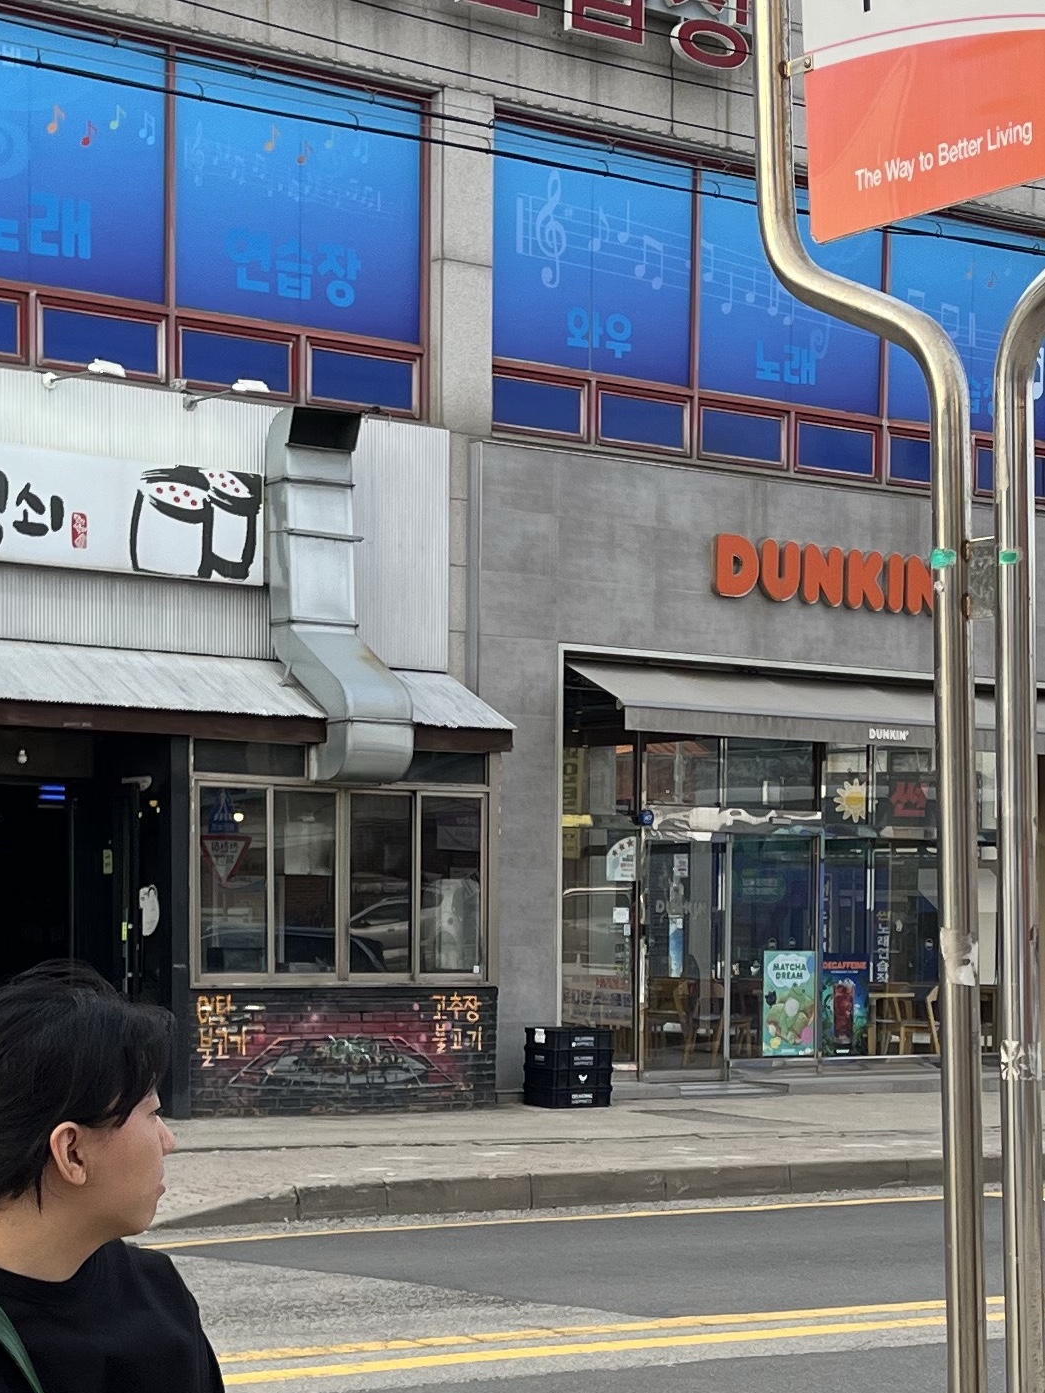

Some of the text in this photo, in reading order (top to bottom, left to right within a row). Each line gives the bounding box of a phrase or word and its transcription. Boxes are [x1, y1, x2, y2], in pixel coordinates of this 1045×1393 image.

[855, 121, 1033, 192] The Way to Better Living
[225, 225, 360, 308] 연습장
[566, 307, 632, 358] 와우
[756, 339, 817, 386] 노래
[868, 728, 910, 740] DUNKIN'
[772, 963, 807, 972] MATCHA
[775, 972, 803, 980] DREAM
[432, 991, 483, 1023] 고추장
